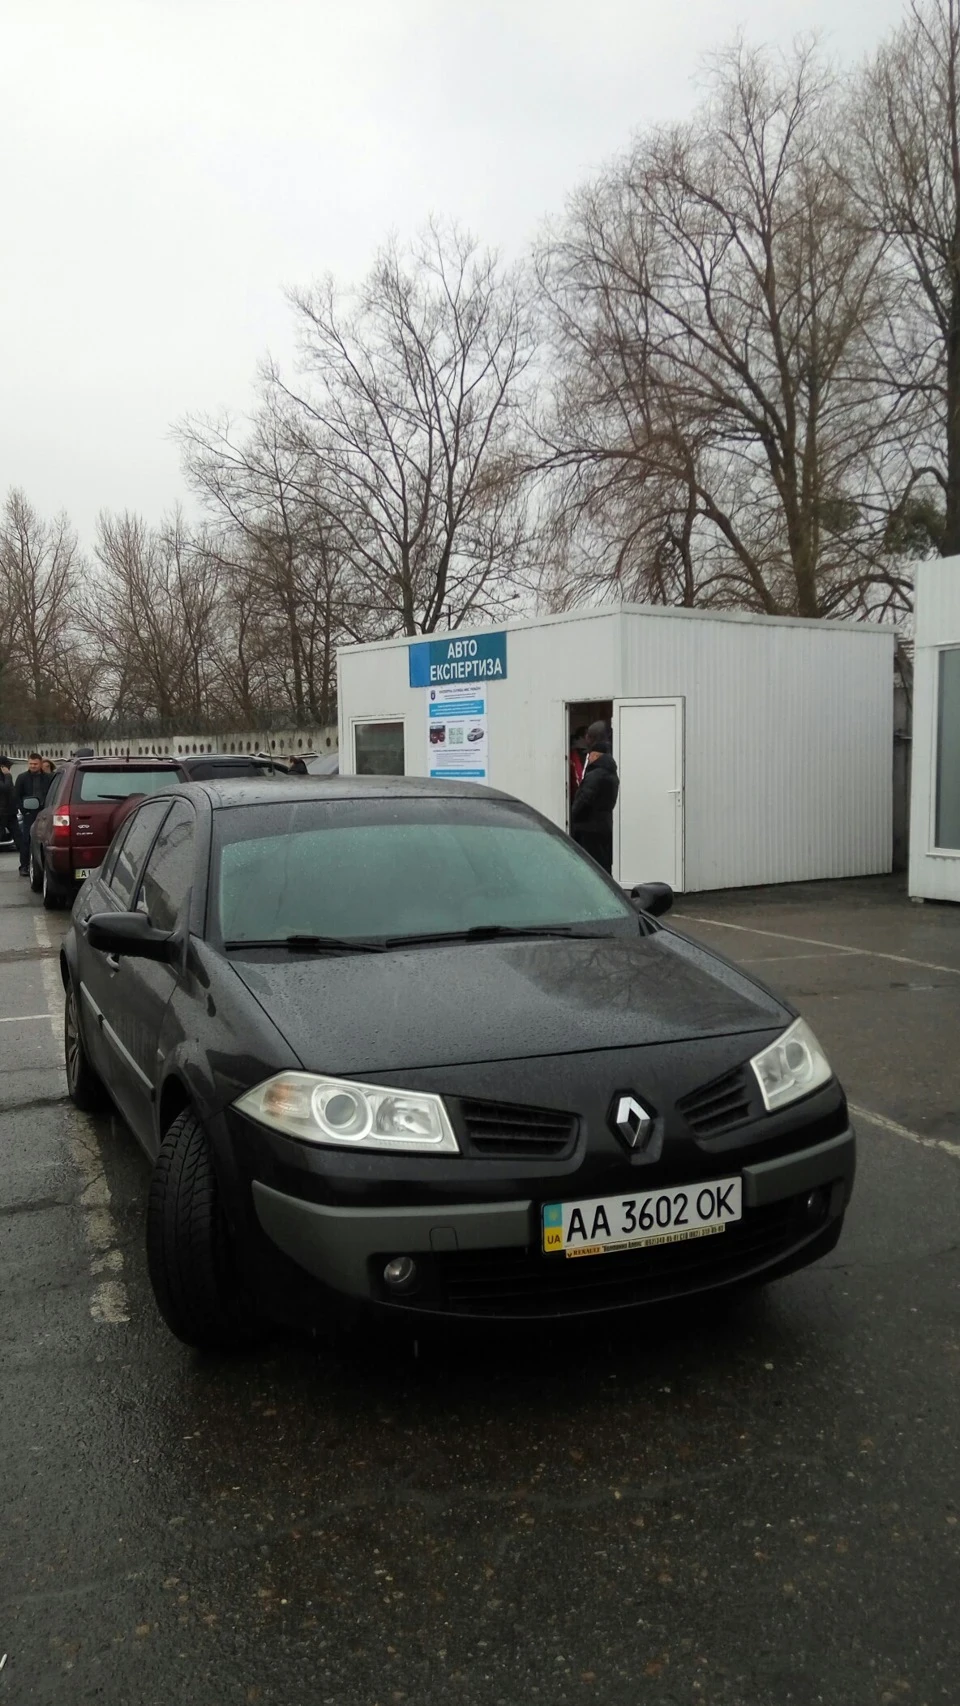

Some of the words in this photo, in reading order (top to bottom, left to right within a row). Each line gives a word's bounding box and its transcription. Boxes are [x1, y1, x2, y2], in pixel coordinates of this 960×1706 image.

[447, 639, 478, 659] АВТО
[430, 658, 503, 681] ЕКСПЕРТИЗА
[566, 1204, 612, 1243] AA
[621, 1193, 689, 1234] 3602
[696, 1184, 735, 1221] OK
[547, 1234, 561, 1245] UA
[573, 1247, 600, 1256] RENAULT
